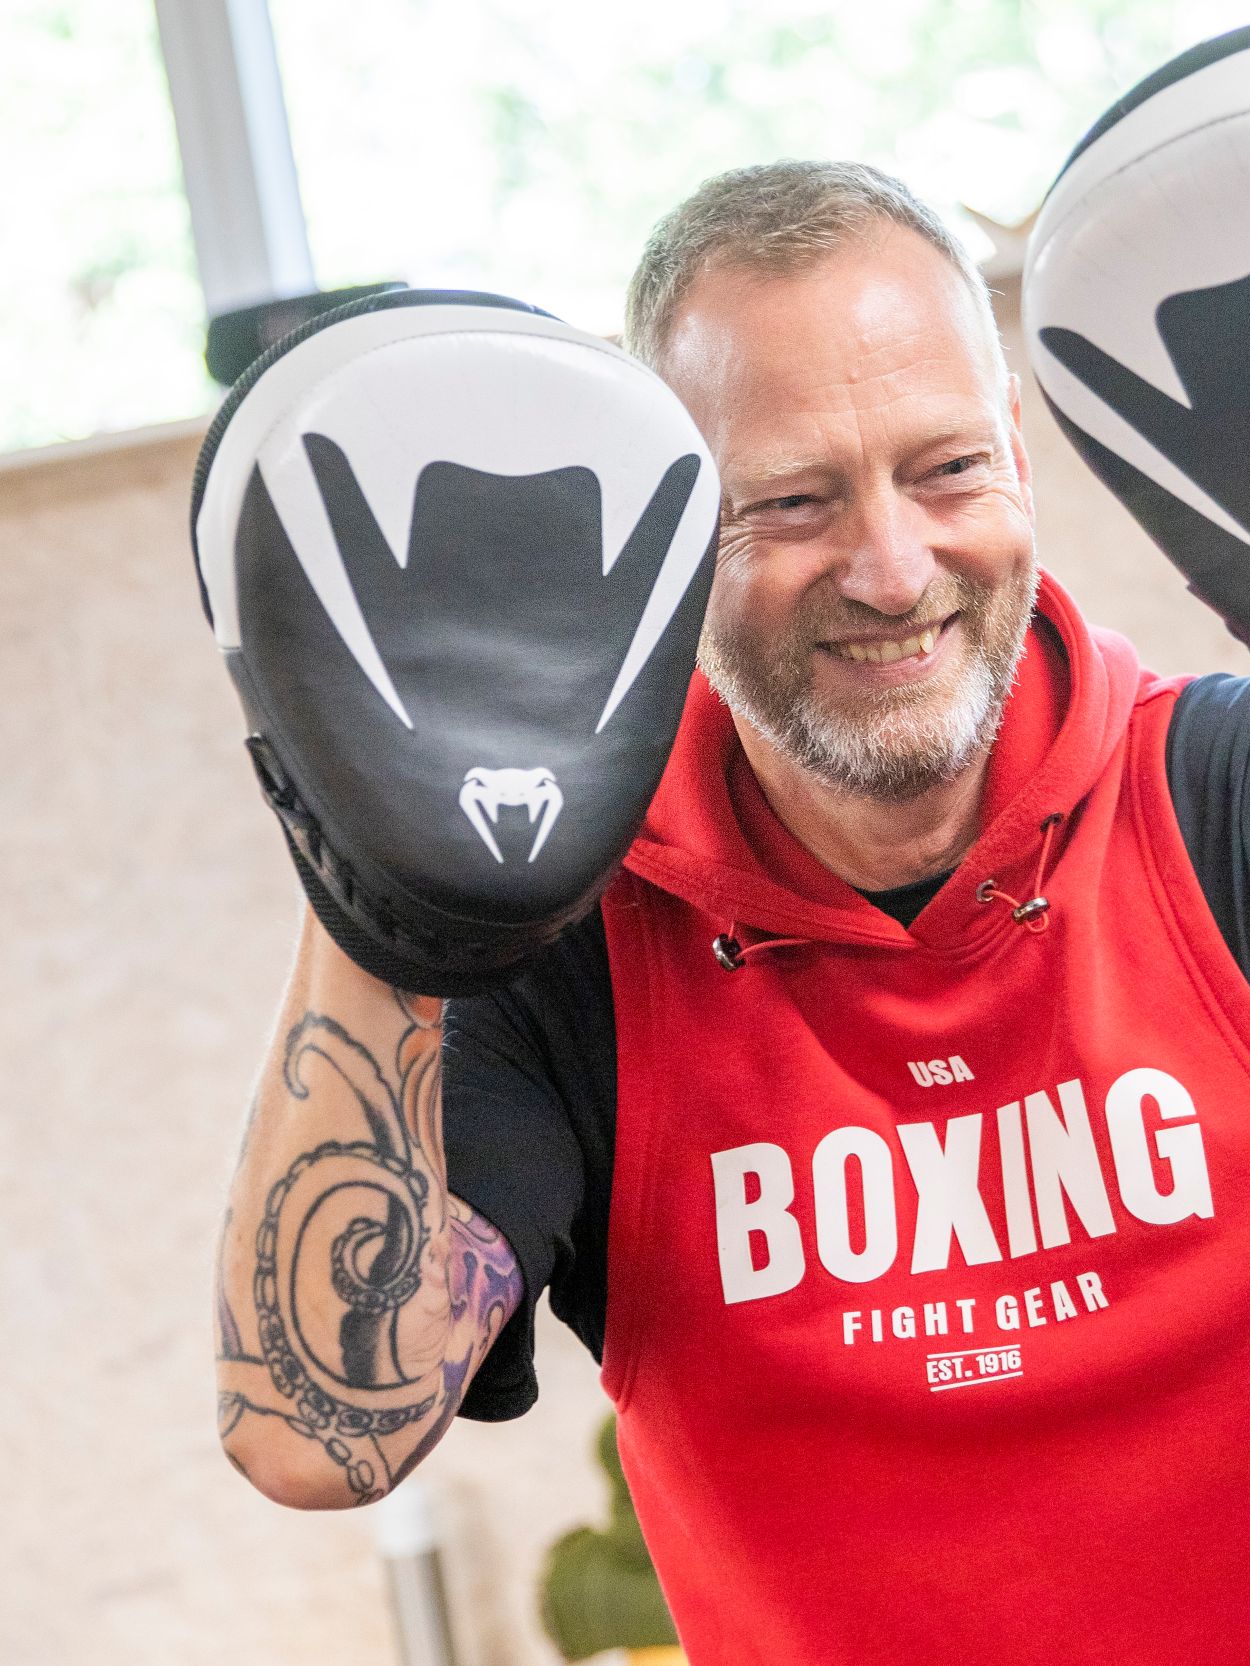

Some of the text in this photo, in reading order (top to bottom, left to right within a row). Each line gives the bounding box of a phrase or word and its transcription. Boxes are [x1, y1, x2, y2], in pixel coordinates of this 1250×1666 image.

[908, 1056, 975, 1088] USA
[710, 1067, 1215, 1305] BOXING
[842, 1271, 1110, 1345] FIGHT GEAR
[926, 1349, 1022, 1384] EST. 1916
